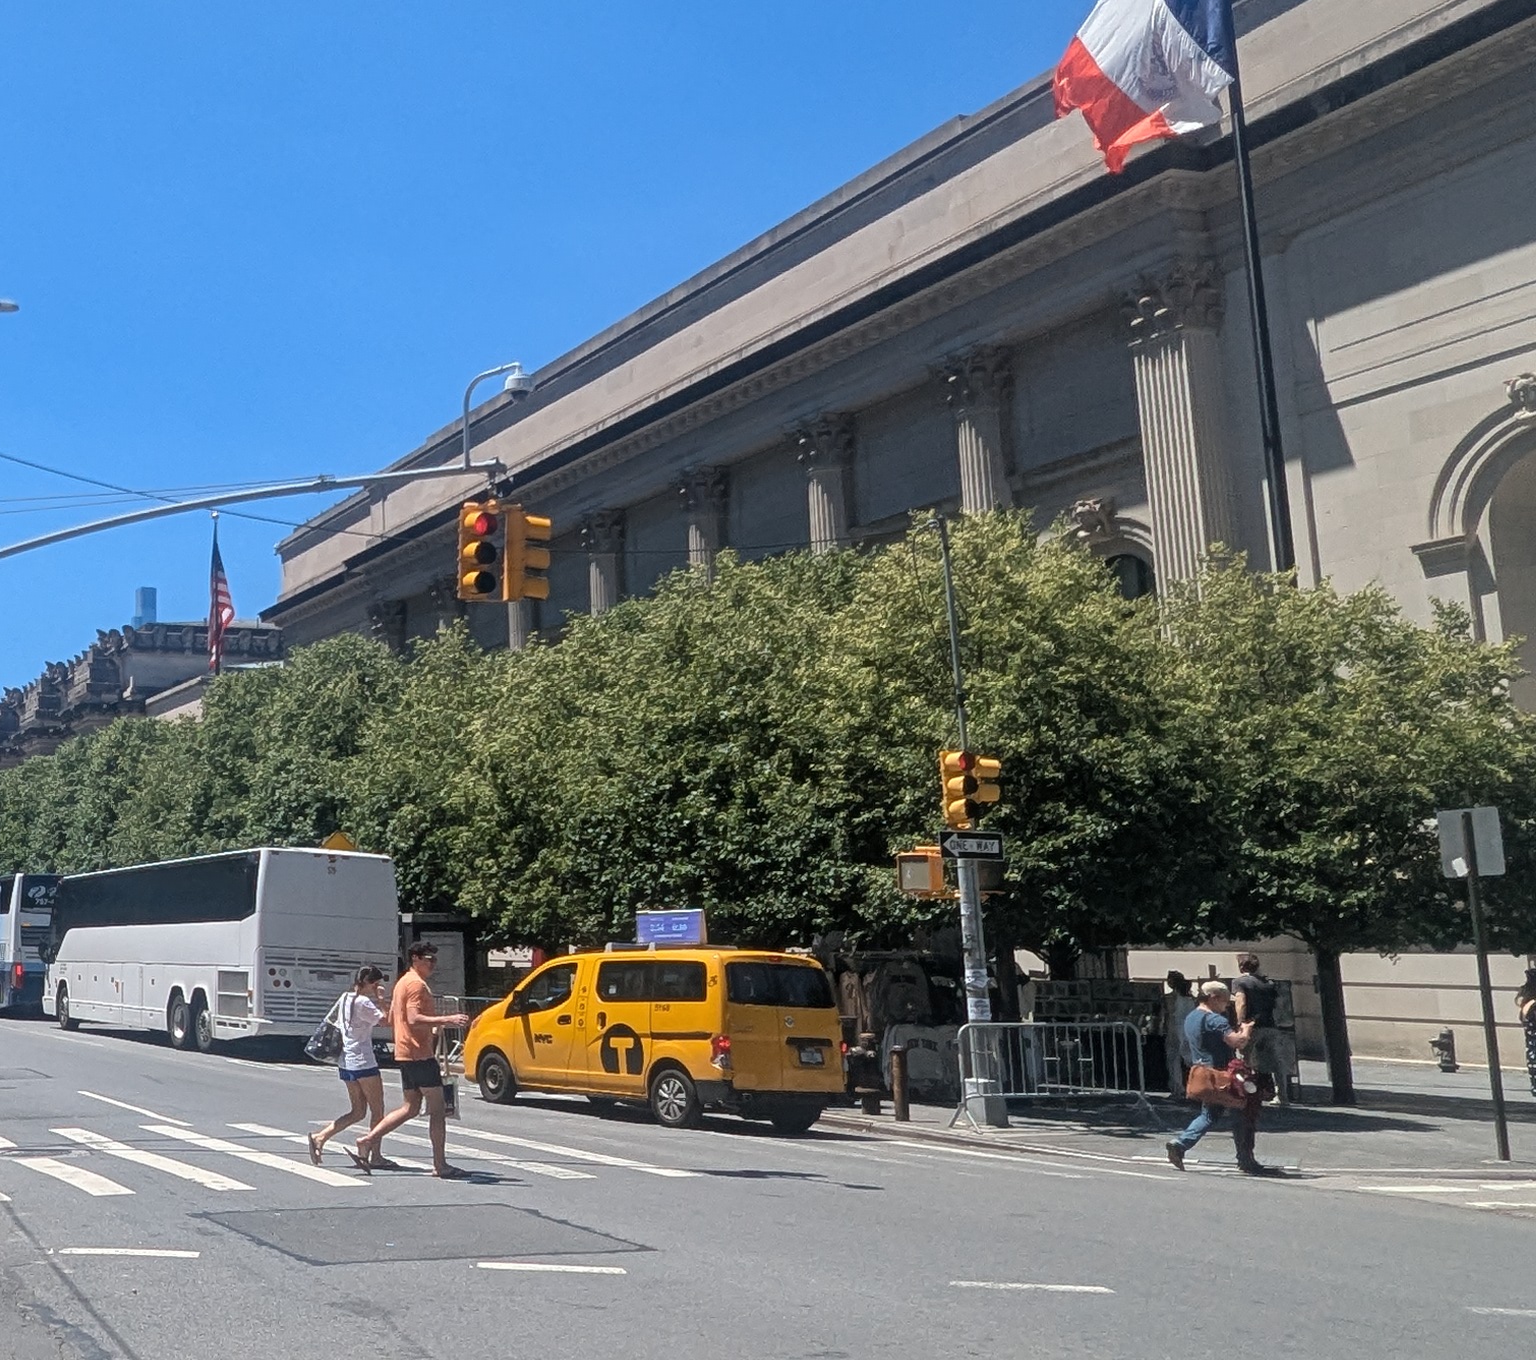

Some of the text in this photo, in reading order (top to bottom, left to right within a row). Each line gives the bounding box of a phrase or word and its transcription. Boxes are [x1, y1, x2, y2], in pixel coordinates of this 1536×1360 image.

[949, 840, 995, 852] ONE WAY
[534, 1033, 553, 1044] NYC
[609, 1036, 635, 1074] T
